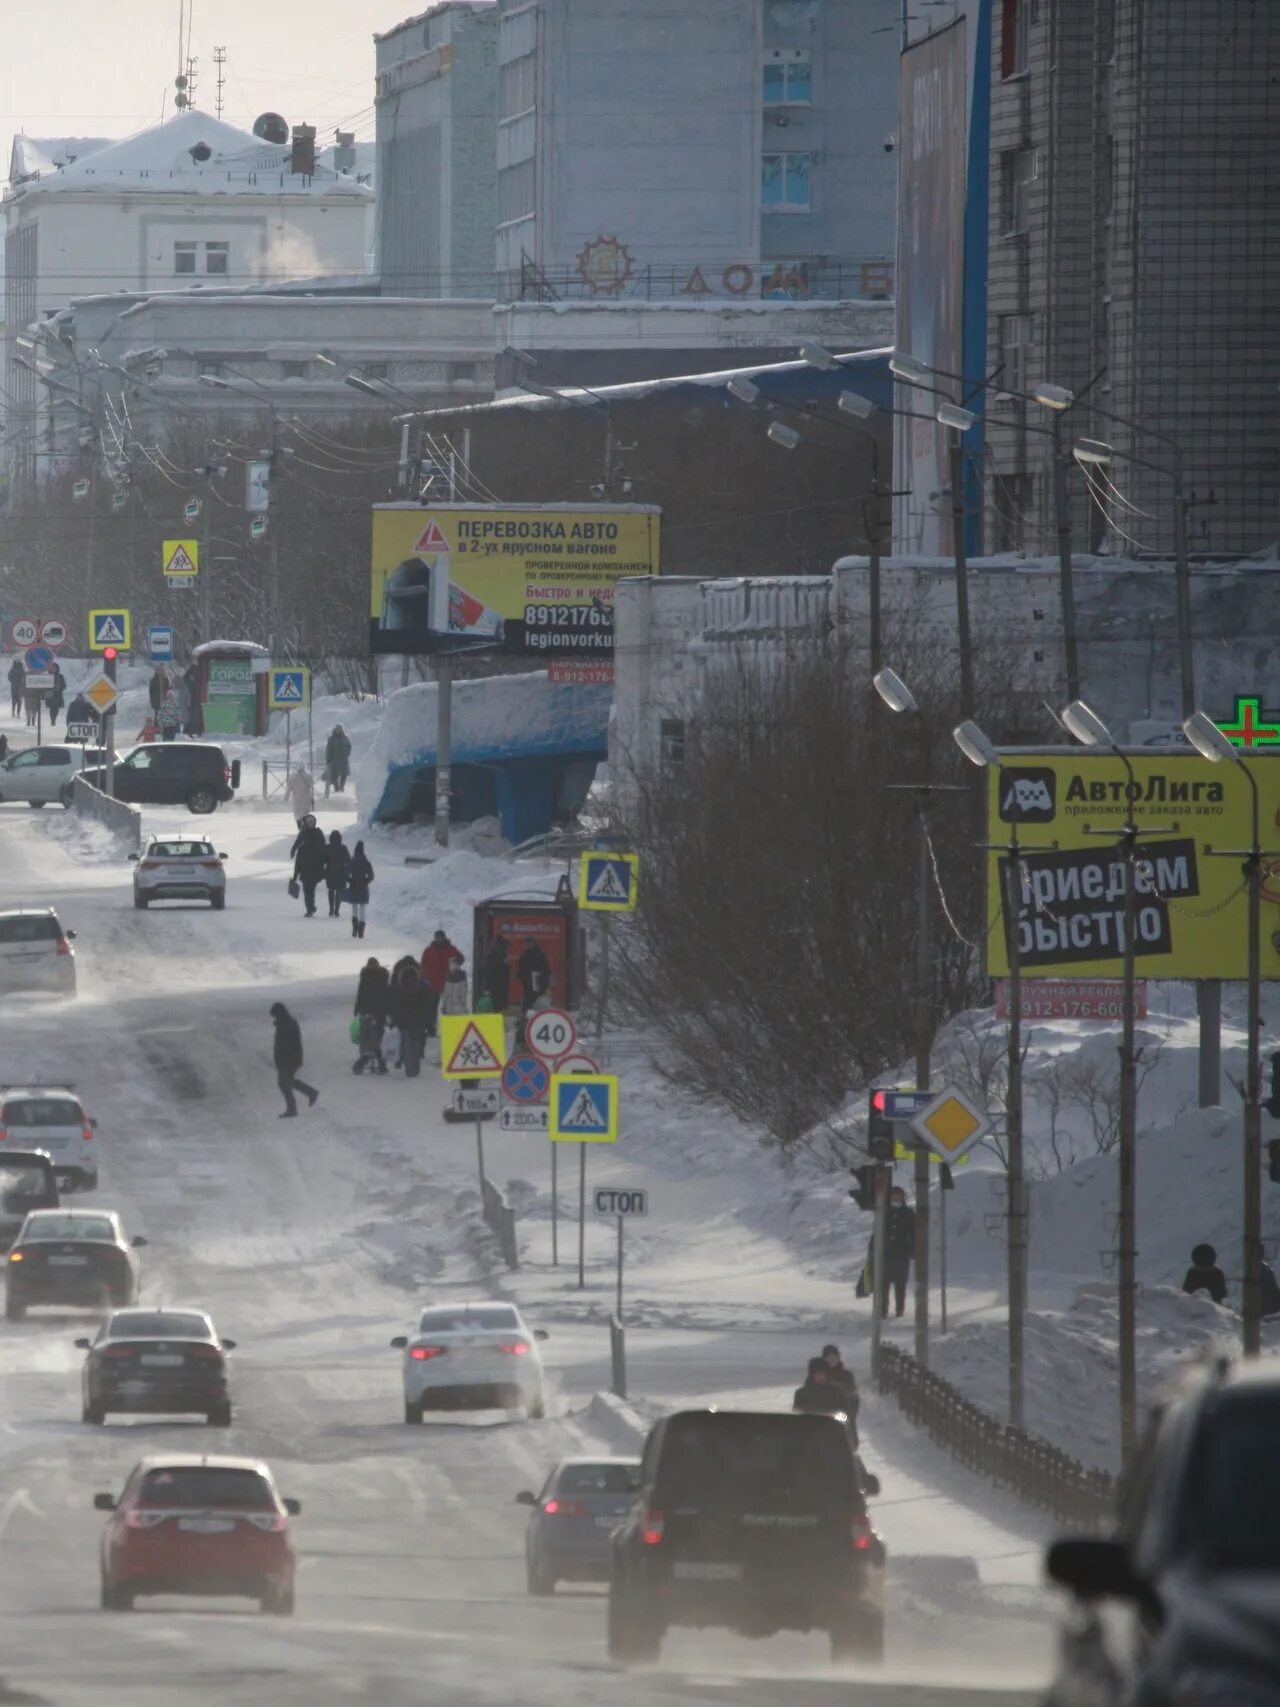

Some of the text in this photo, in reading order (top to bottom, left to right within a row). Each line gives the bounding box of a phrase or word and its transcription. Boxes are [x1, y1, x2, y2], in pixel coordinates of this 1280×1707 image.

[458, 521, 618, 539] ПЕРЕВОЗКА АВТО
[458, 543, 467, 553] в
[470, 540, 498, 555] 2-ух
[502, 542, 564, 556] ярусном
[567, 543, 617, 555] вагоне
[526, 585, 571, 600] Быстро
[576, 588, 584, 598] и
[16, 627, 34, 639] 40
[525, 631, 615, 649] legionvorku
[69, 724, 98, 737] СТОП
[1065, 775, 1224, 802] АвтоЛига
[1195, 806, 1224, 816] авто
[1004, 986, 1141, 997] НРУЖНАЯ РЕКЛАА
[536, 1023, 565, 1045] 40
[595, 1190, 645, 1213] СТОП
